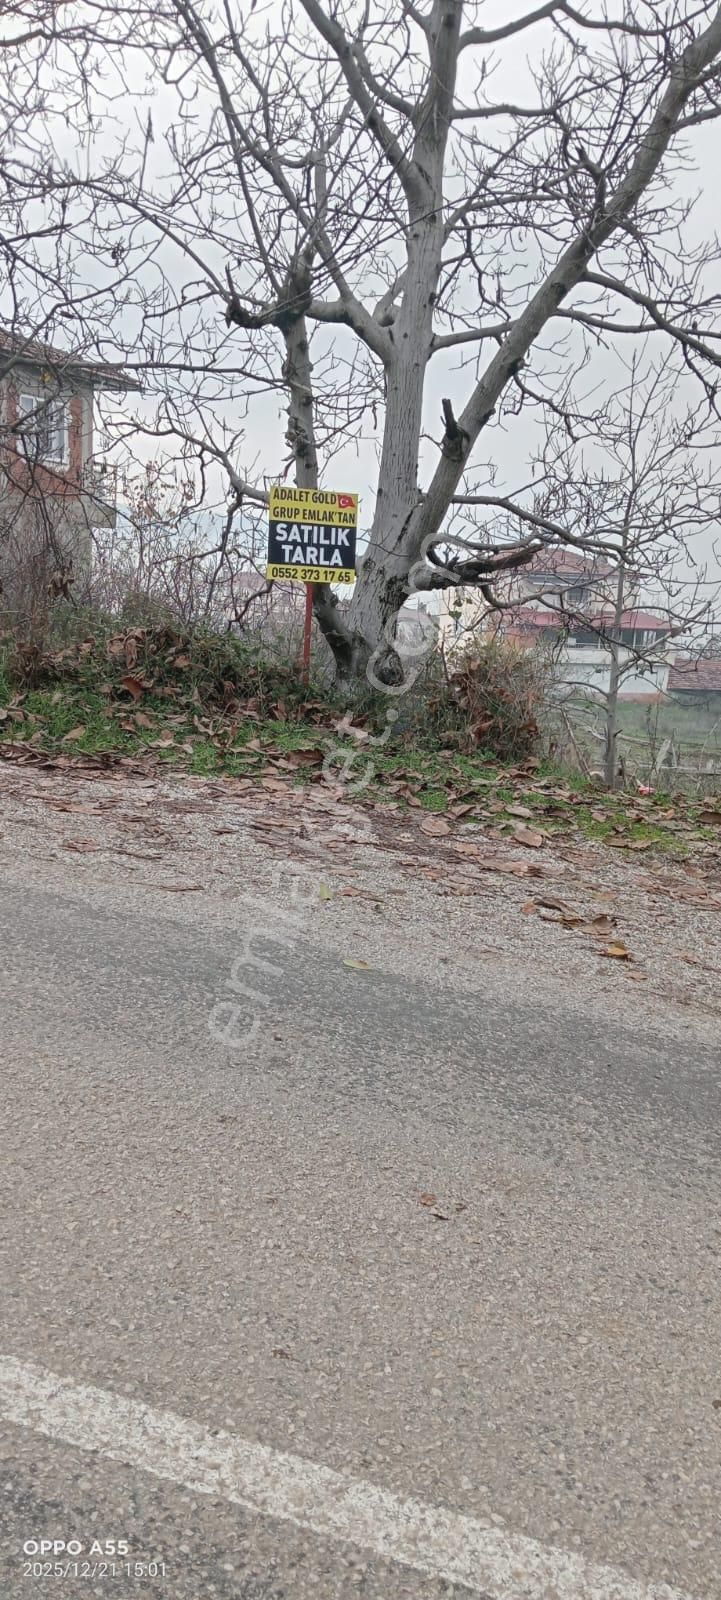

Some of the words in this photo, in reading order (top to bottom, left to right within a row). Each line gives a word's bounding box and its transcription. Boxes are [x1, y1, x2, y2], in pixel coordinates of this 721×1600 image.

[273, 488, 310, 502] ADALET
[312, 492, 336, 505] GOLD
[272, 506, 300, 519] GRUP
[303, 509, 355, 524] EMLAK'TAN
[275, 523, 350, 546] SATILIK
[281, 544, 344, 566] TARLA
[271, 567, 298, 579] 0552
[301, 569, 320, 581] 373
[323, 571, 335, 581] 17
[338, 571, 351, 582] 65
